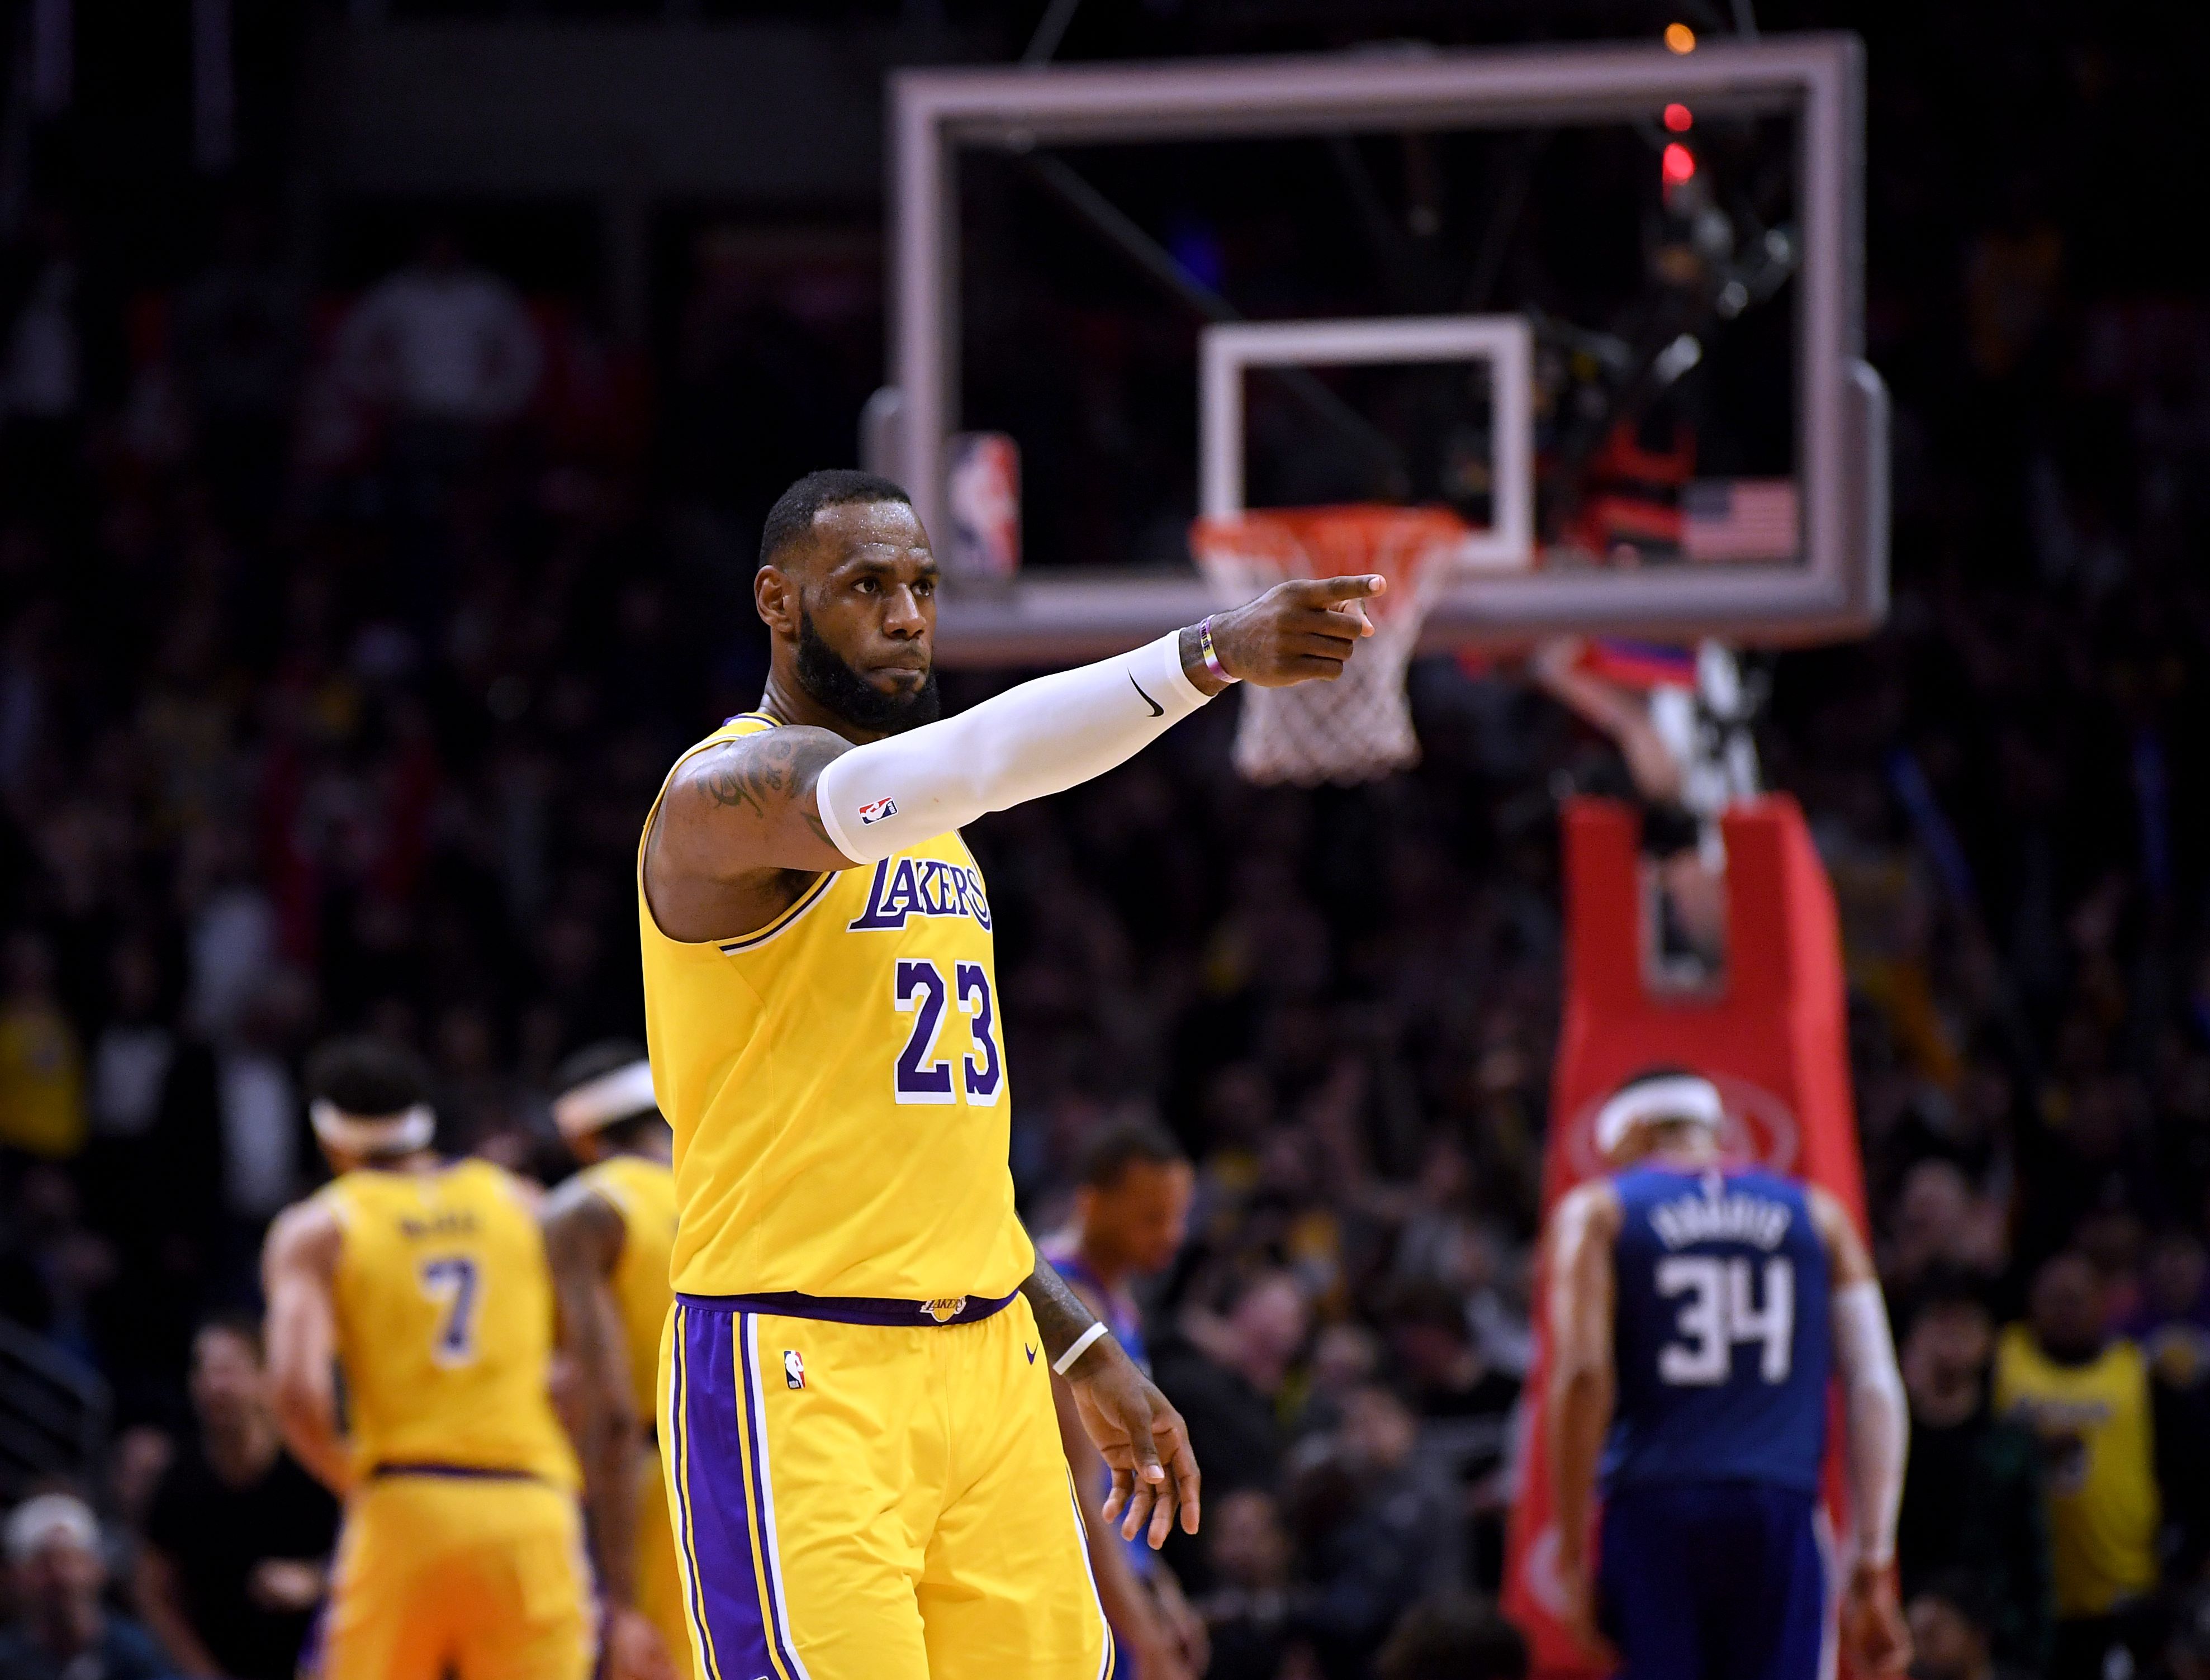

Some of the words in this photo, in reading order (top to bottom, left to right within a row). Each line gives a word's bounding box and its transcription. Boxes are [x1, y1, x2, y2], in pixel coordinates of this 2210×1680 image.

[846, 855, 992, 933] LAKERS
[894, 957, 1004, 1107] 23
[415, 1256, 489, 1369] 7
[1655, 1256, 1794, 1385] 34
